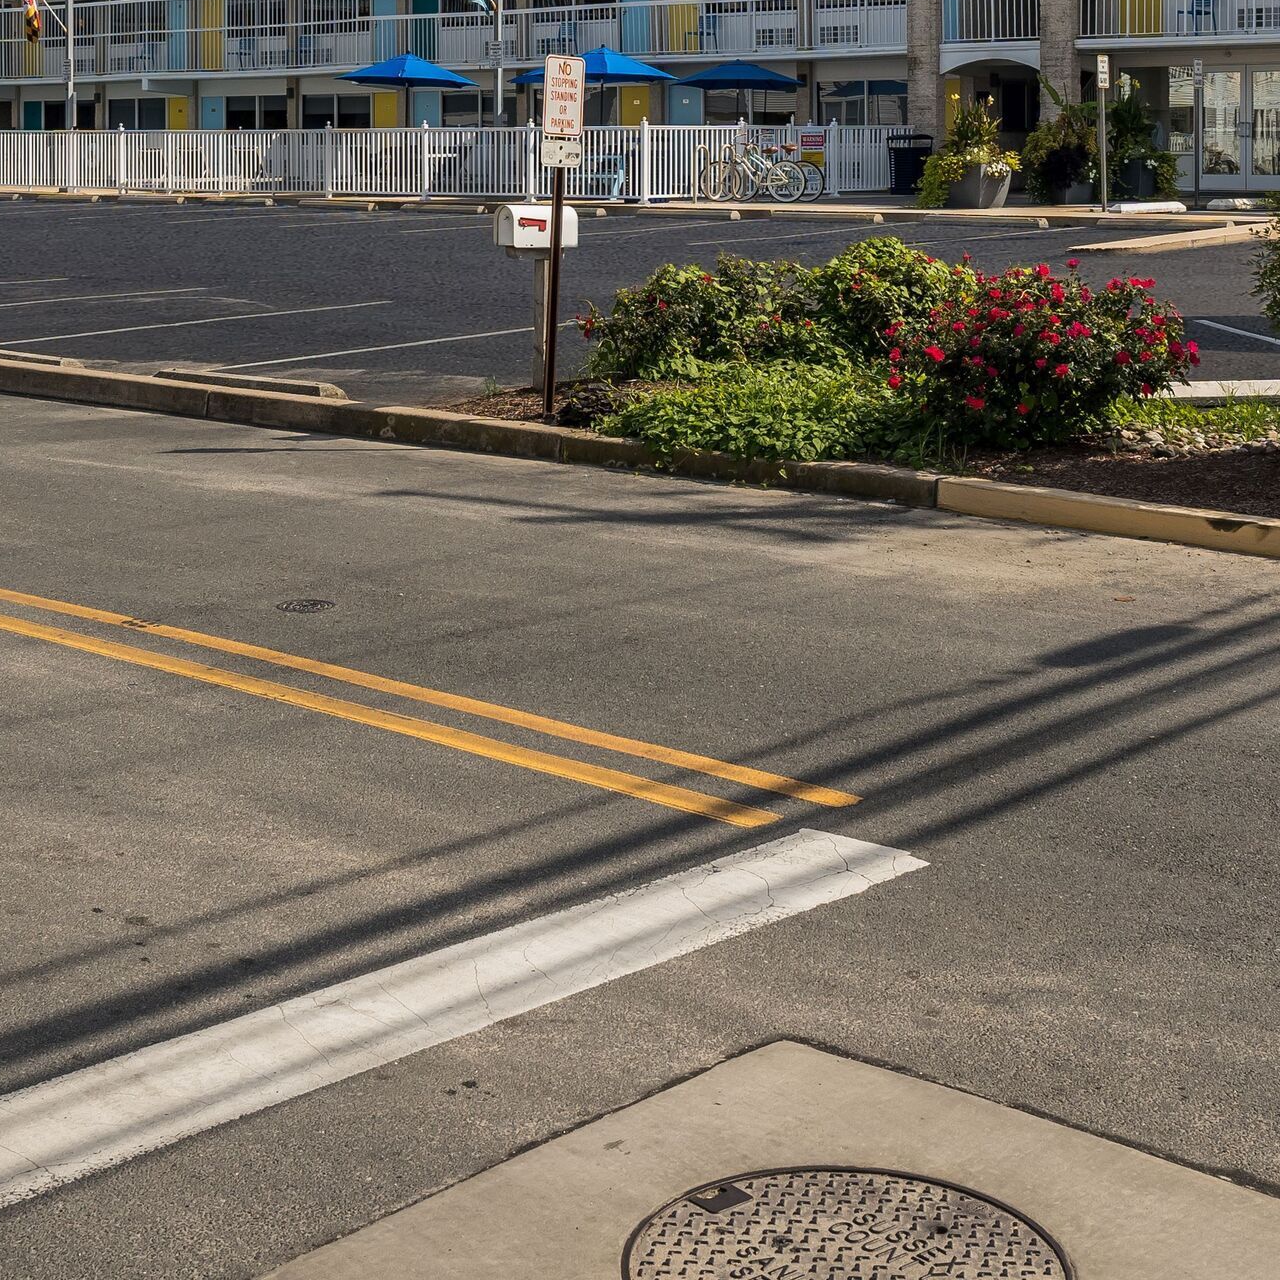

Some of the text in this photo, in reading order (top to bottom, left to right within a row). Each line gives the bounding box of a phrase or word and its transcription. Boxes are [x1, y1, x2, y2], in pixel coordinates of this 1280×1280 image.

[558, 62, 572, 76] NO
[551, 77, 577, 89] STOPPING
[551, 90, 577, 102] STANDING
[559, 104, 568, 115] OR
[551, 118, 575, 129] PARKING
[852, 1213, 968, 1274] SUSSEX
[828, 1221, 949, 1280] COUNTY
